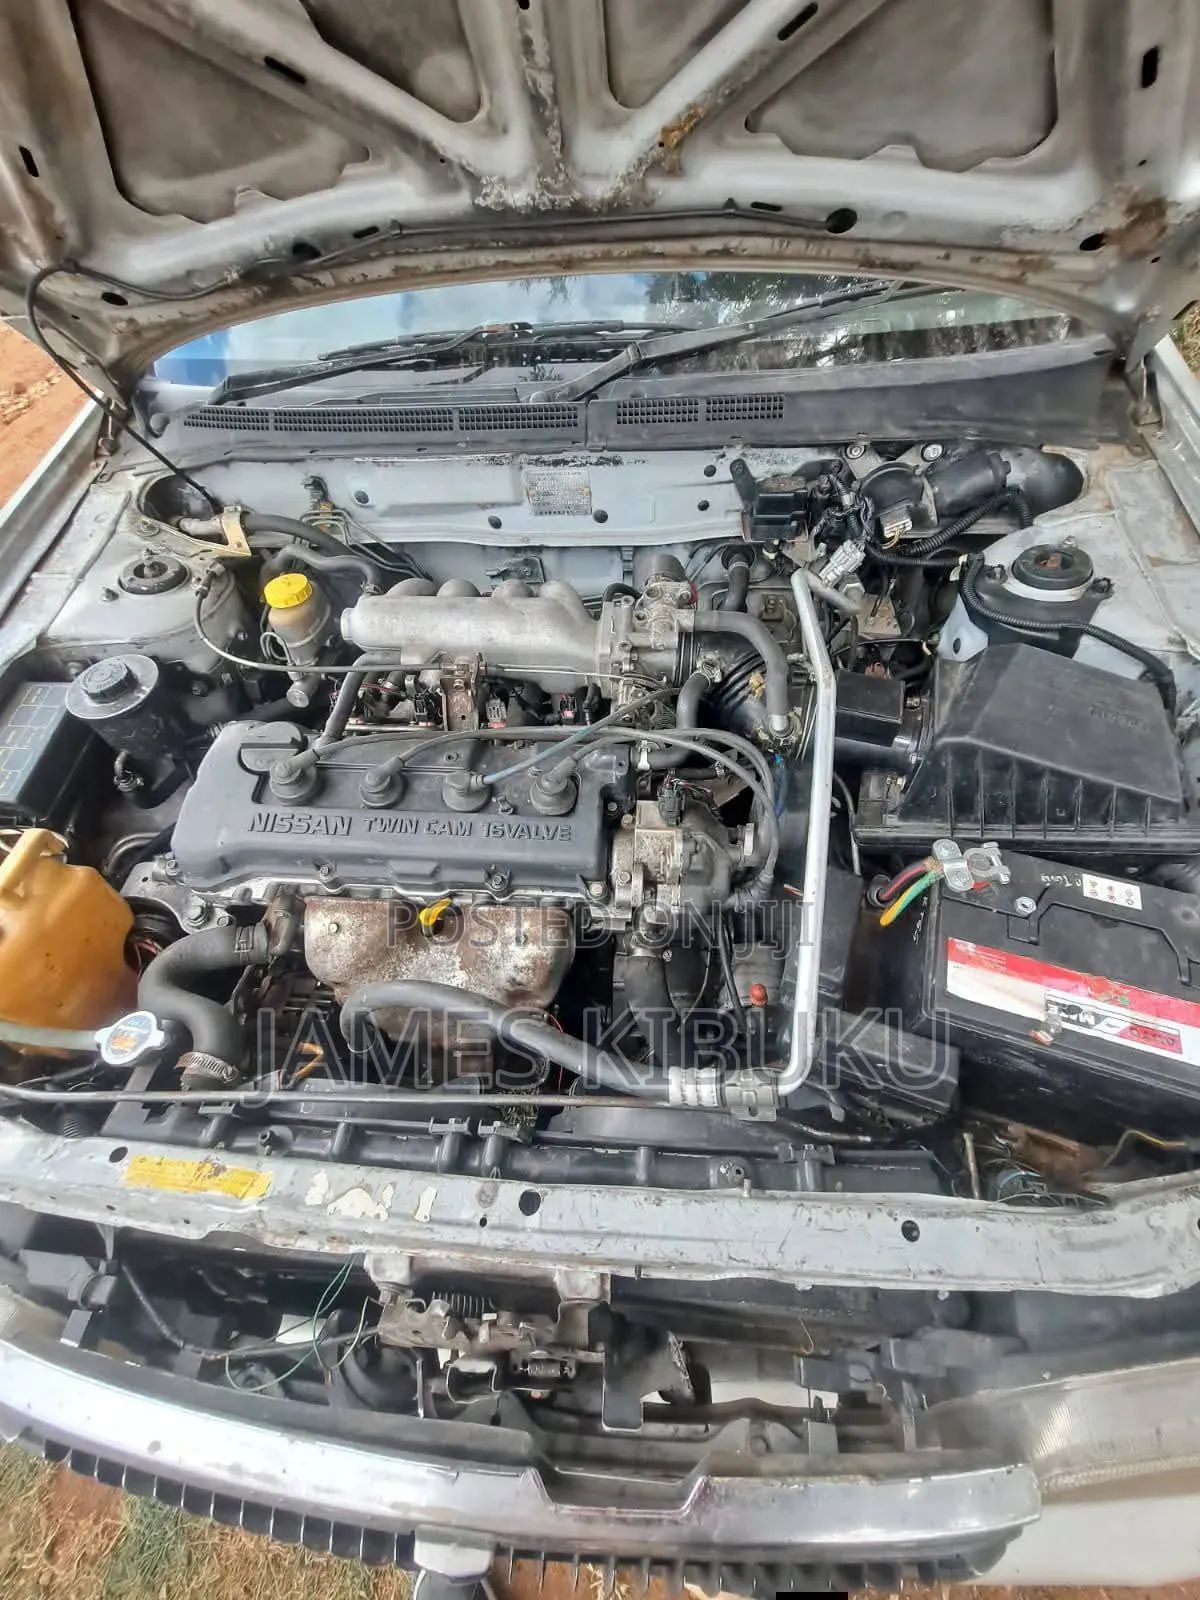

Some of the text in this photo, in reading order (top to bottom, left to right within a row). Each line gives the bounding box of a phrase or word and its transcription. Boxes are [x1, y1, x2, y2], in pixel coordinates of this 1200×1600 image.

[247, 812, 574, 841] NISSAN TWIN CAM 16VALVE
